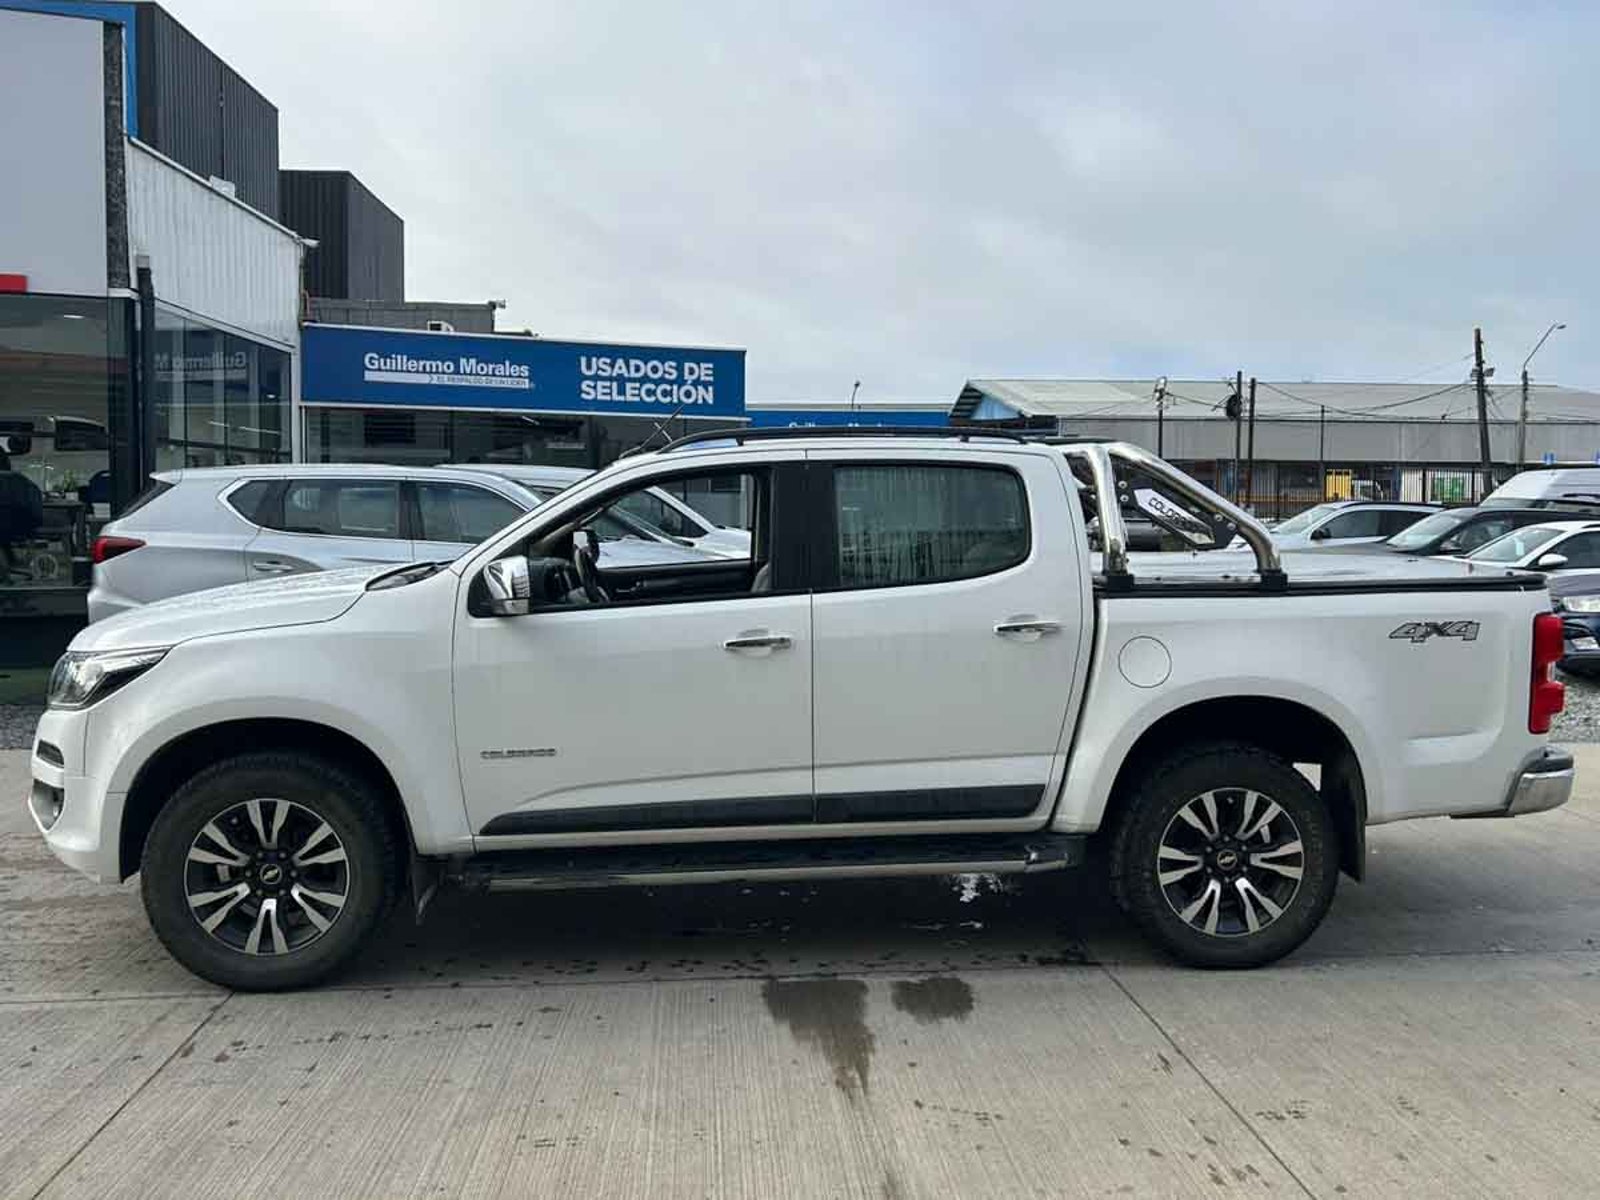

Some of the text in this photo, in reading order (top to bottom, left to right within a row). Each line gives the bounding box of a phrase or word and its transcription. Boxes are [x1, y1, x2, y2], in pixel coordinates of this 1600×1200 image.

[364, 353, 529, 377] Guillermo Morales
[580, 356, 714, 381] USADOS DE
[580, 379, 714, 404] SELECCIÓN
[1148, 497, 1200, 534] COLORA
